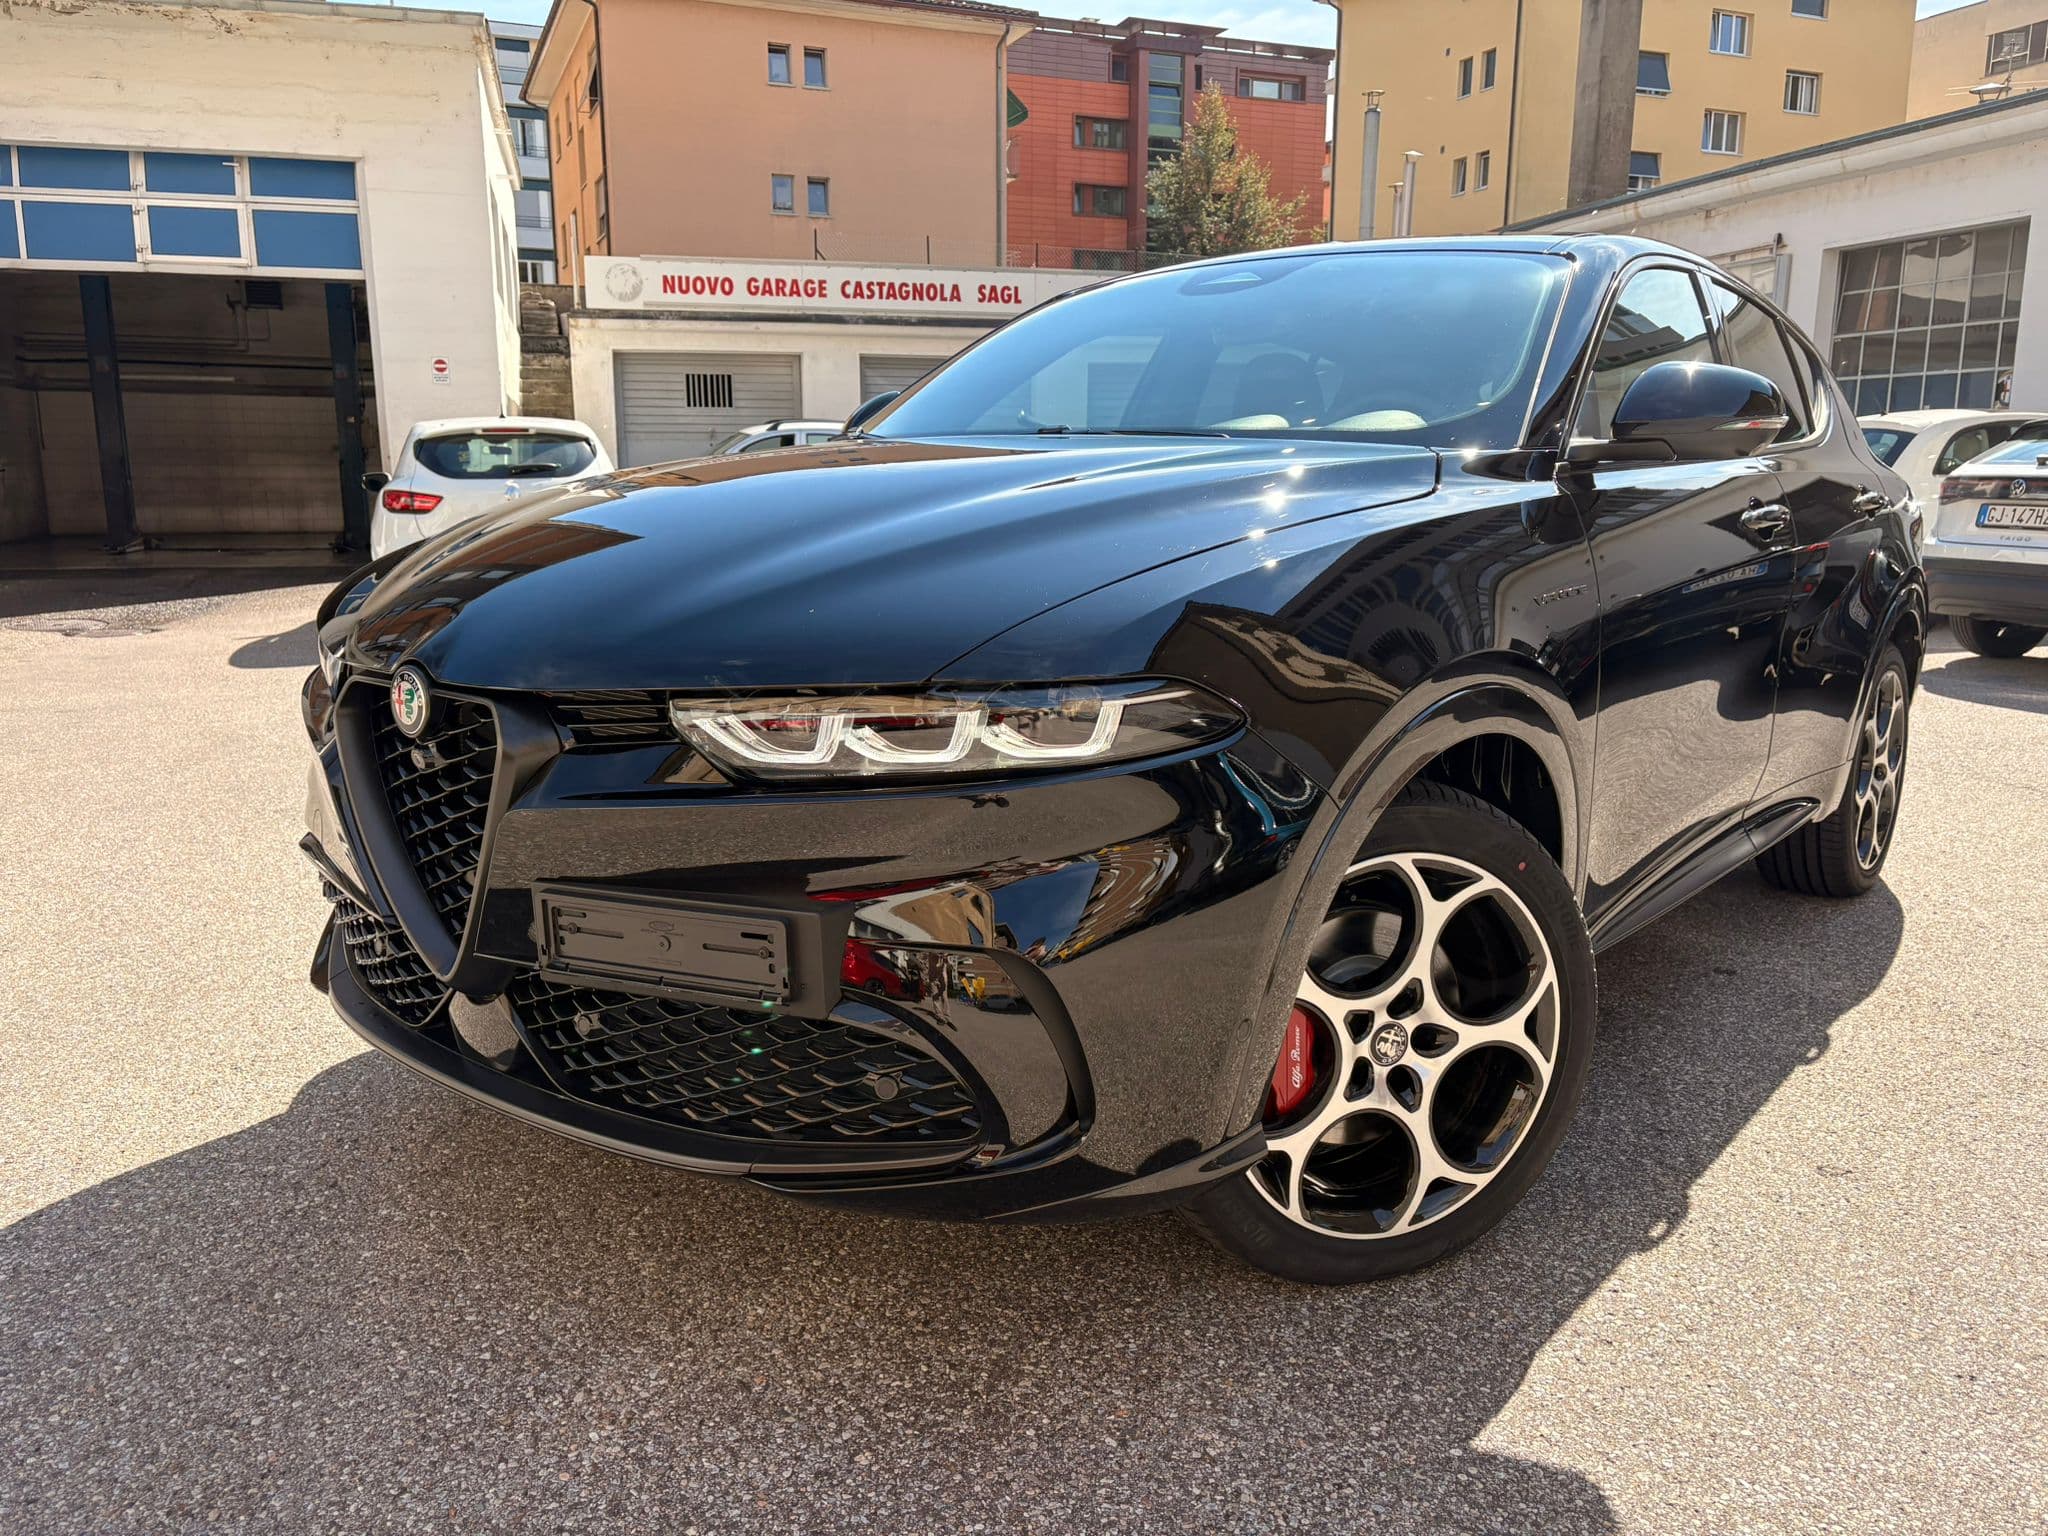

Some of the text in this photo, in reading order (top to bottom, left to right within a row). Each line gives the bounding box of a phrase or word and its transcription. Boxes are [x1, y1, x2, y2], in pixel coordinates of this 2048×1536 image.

[662, 274, 1023, 304] NUOVO GARAGE CASTAGNOLA SAGL
